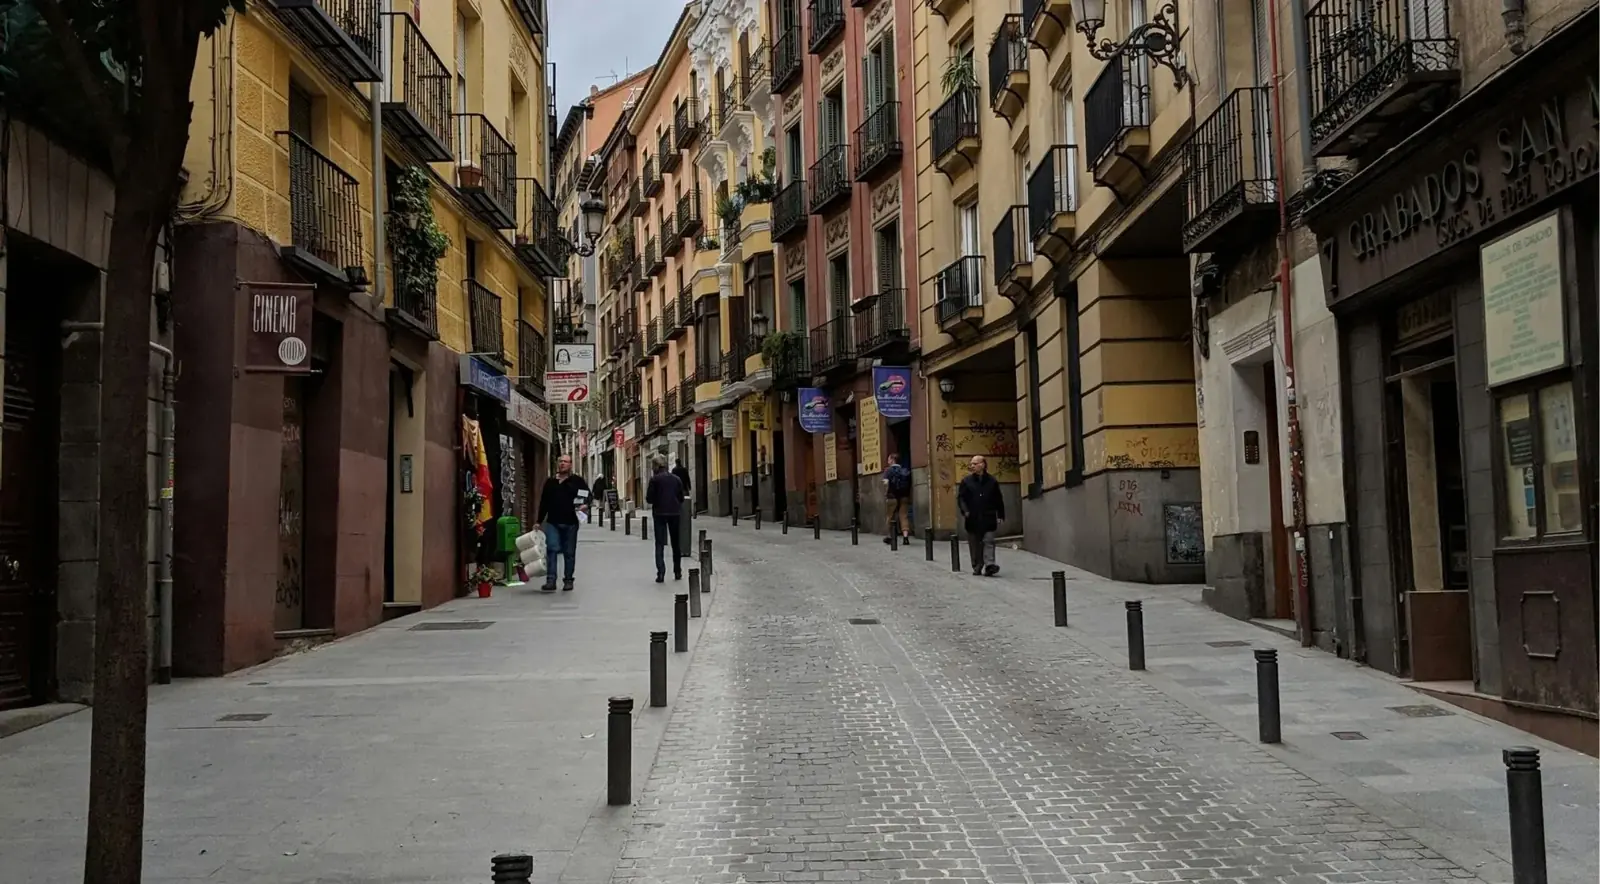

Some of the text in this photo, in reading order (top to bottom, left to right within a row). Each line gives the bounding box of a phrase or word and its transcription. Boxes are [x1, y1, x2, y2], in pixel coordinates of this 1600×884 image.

[1350, 149, 1480, 259] GRABADOS
[1497, 96, 1566, 176] SAN
[1478, 198, 1495, 226] DE
[1322, 237, 1339, 297] 7
[253, 294, 297, 333] CINEMA
[280, 341, 305, 360] ROOM
